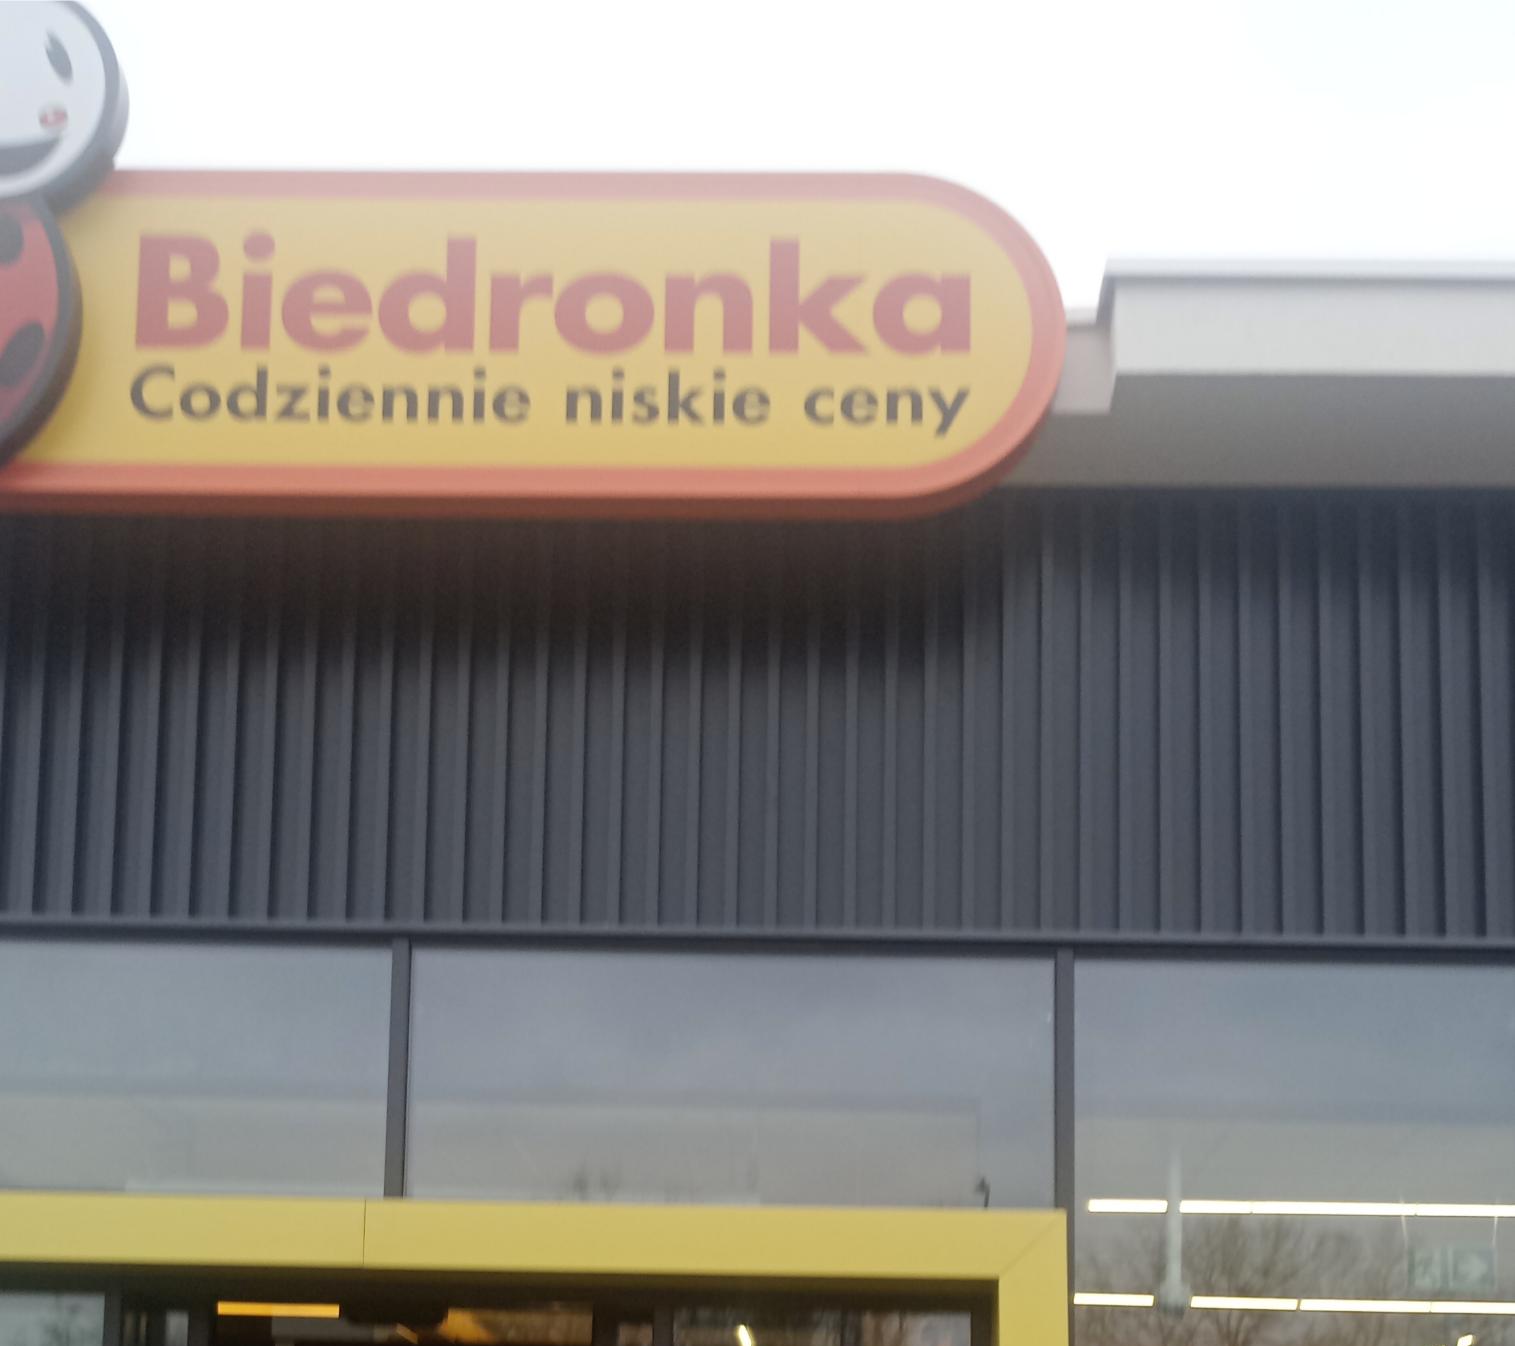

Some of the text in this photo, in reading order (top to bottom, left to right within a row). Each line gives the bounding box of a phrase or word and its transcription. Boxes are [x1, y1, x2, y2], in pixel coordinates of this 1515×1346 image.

[135, 229, 972, 357] Biedronka
[129, 364, 972, 438] Codziennie niskie ceny
